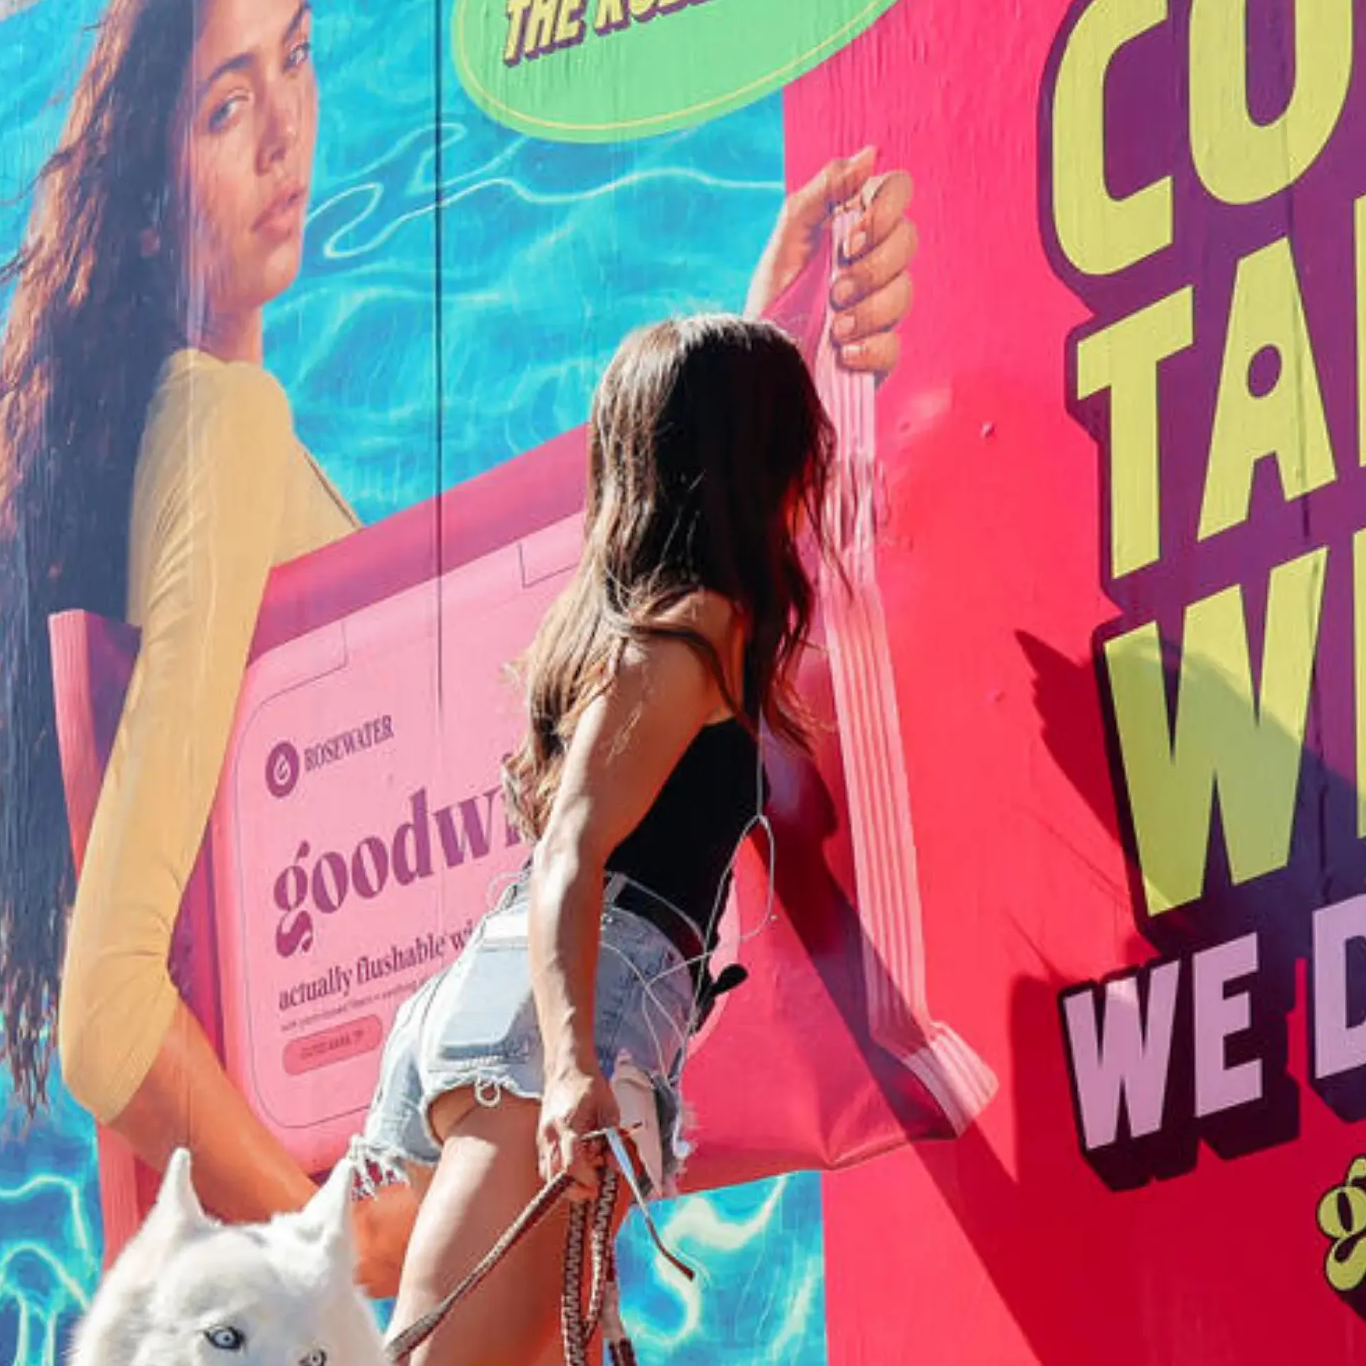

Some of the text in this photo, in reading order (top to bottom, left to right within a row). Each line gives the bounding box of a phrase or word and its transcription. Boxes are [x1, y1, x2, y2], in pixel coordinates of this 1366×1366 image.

[304, 715, 394, 772] ROSEWATER
[279, 963, 352, 1011] actually
[356, 935, 446, 984] flushable
[1063, 930, 1263, 1150] WE
